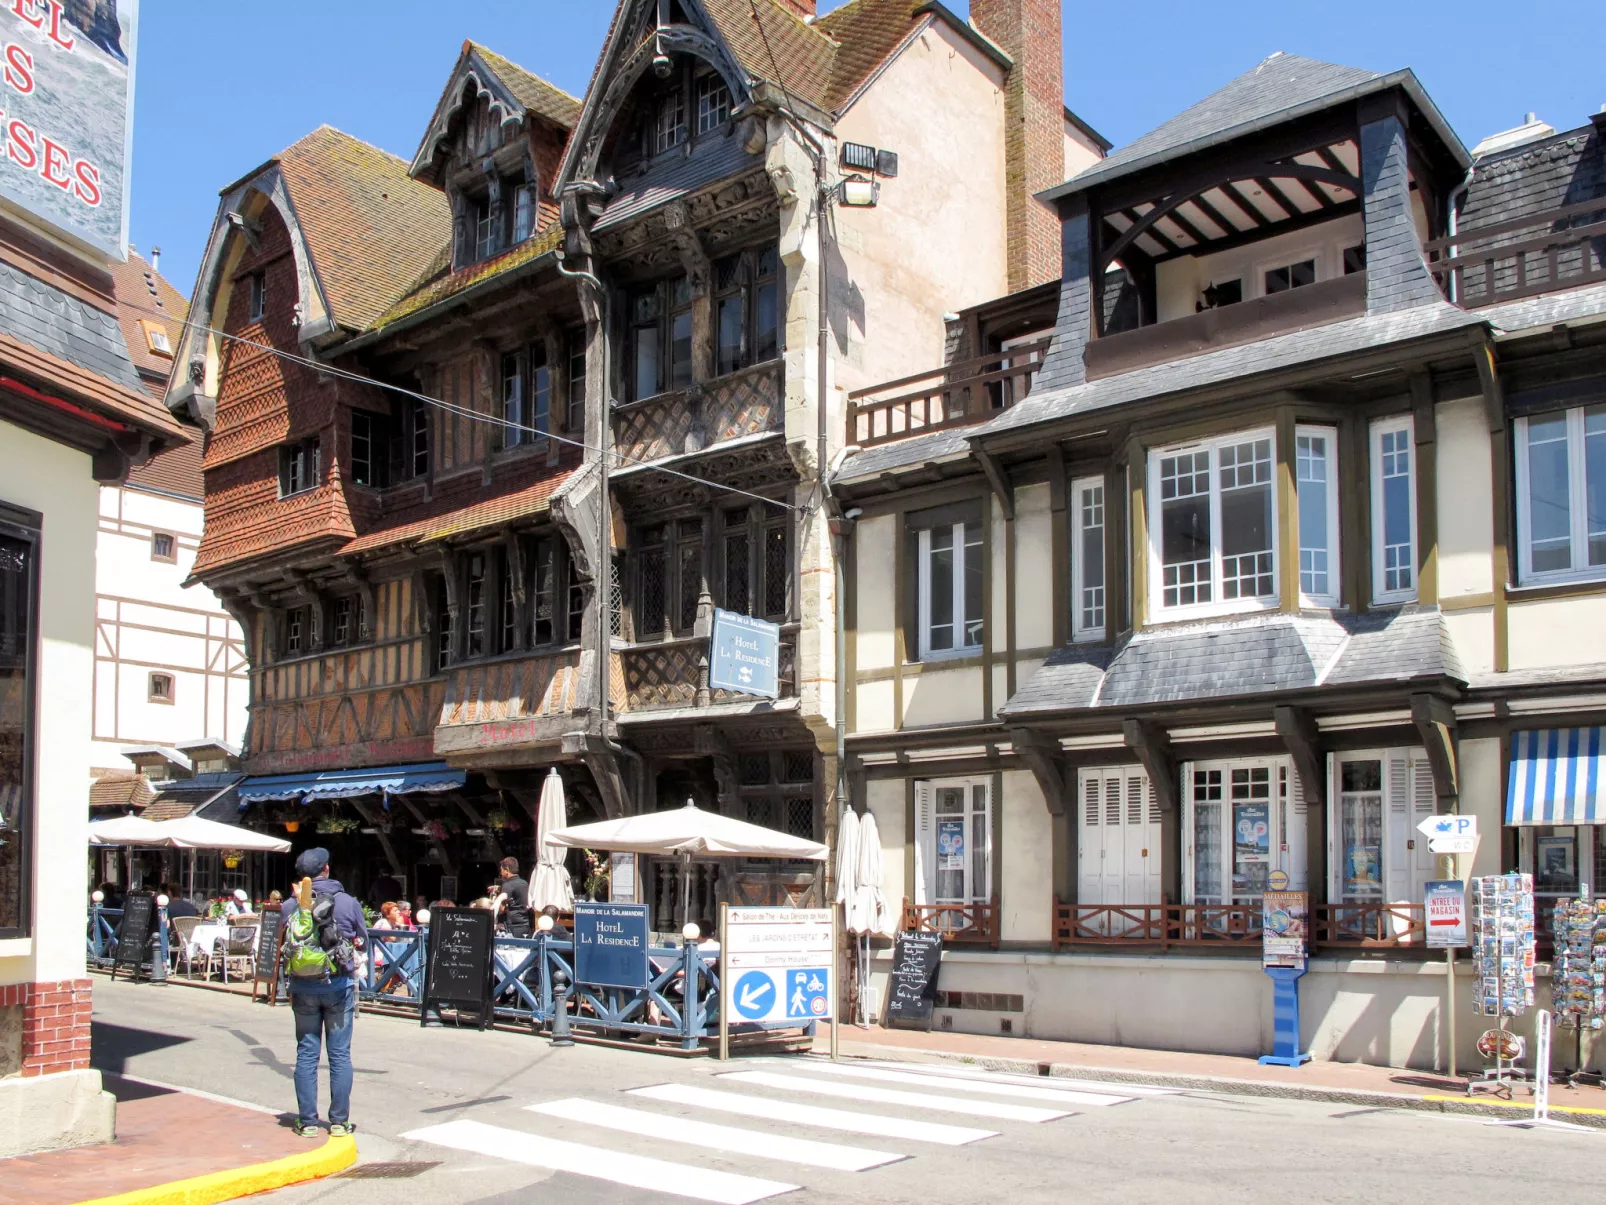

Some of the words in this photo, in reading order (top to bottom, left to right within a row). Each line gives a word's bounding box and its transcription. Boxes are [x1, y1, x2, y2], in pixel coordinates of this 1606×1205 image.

[0, 109, 100, 205] SES
[735, 635, 759, 650] HOTEL
[735, 650, 771, 667] RESIDENCE
[1456, 819, 1470, 834] P
[1264, 891, 1303, 900] MÉDAILLES
[576, 907, 595, 915] MANOIR
[611, 909, 645, 917] SALAMANDRE
[1430, 906, 1460, 915] MAGASIN
[596, 921, 624, 933] HOTEL
[581, 933, 592, 944] LA
[597, 934, 640, 947] RESIDENCE
